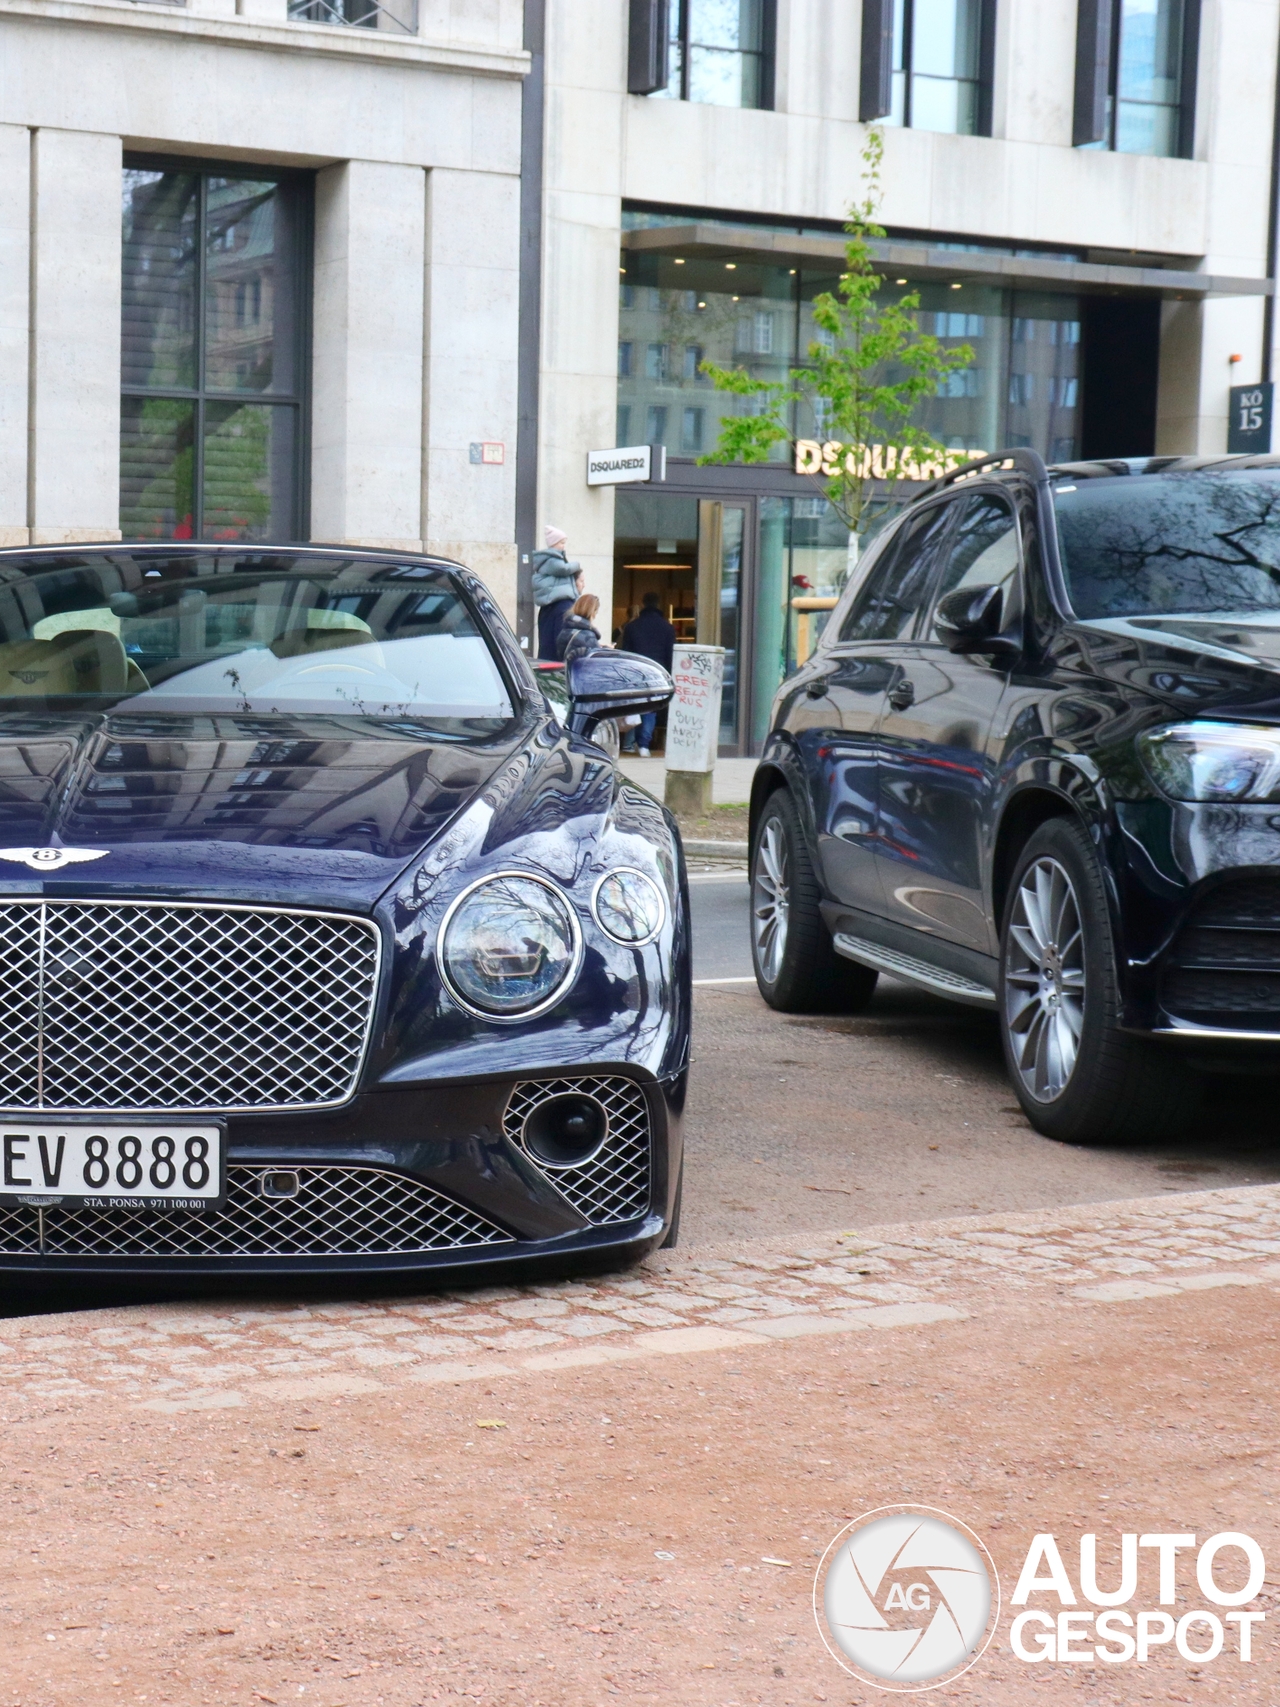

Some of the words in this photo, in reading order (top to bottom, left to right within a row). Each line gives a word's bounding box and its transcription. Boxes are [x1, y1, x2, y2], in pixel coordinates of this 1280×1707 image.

[1239, 408, 1263, 431] 15
[590, 458, 645, 473] DSQUARED2
[675, 674, 708, 687] FREE
[674, 686, 708, 698] BELA
[679, 695, 703, 708] RUS
[3, 1134, 66, 1188] EV
[82, 1135, 210, 1190] 8888
[83, 1198, 107, 1208] STA.
[109, 1199, 146, 1208] PONSA
[150, 1200, 167, 1209] 971
[171, 1200, 188, 1209] 100
[189, 1200, 206, 1209] 001
